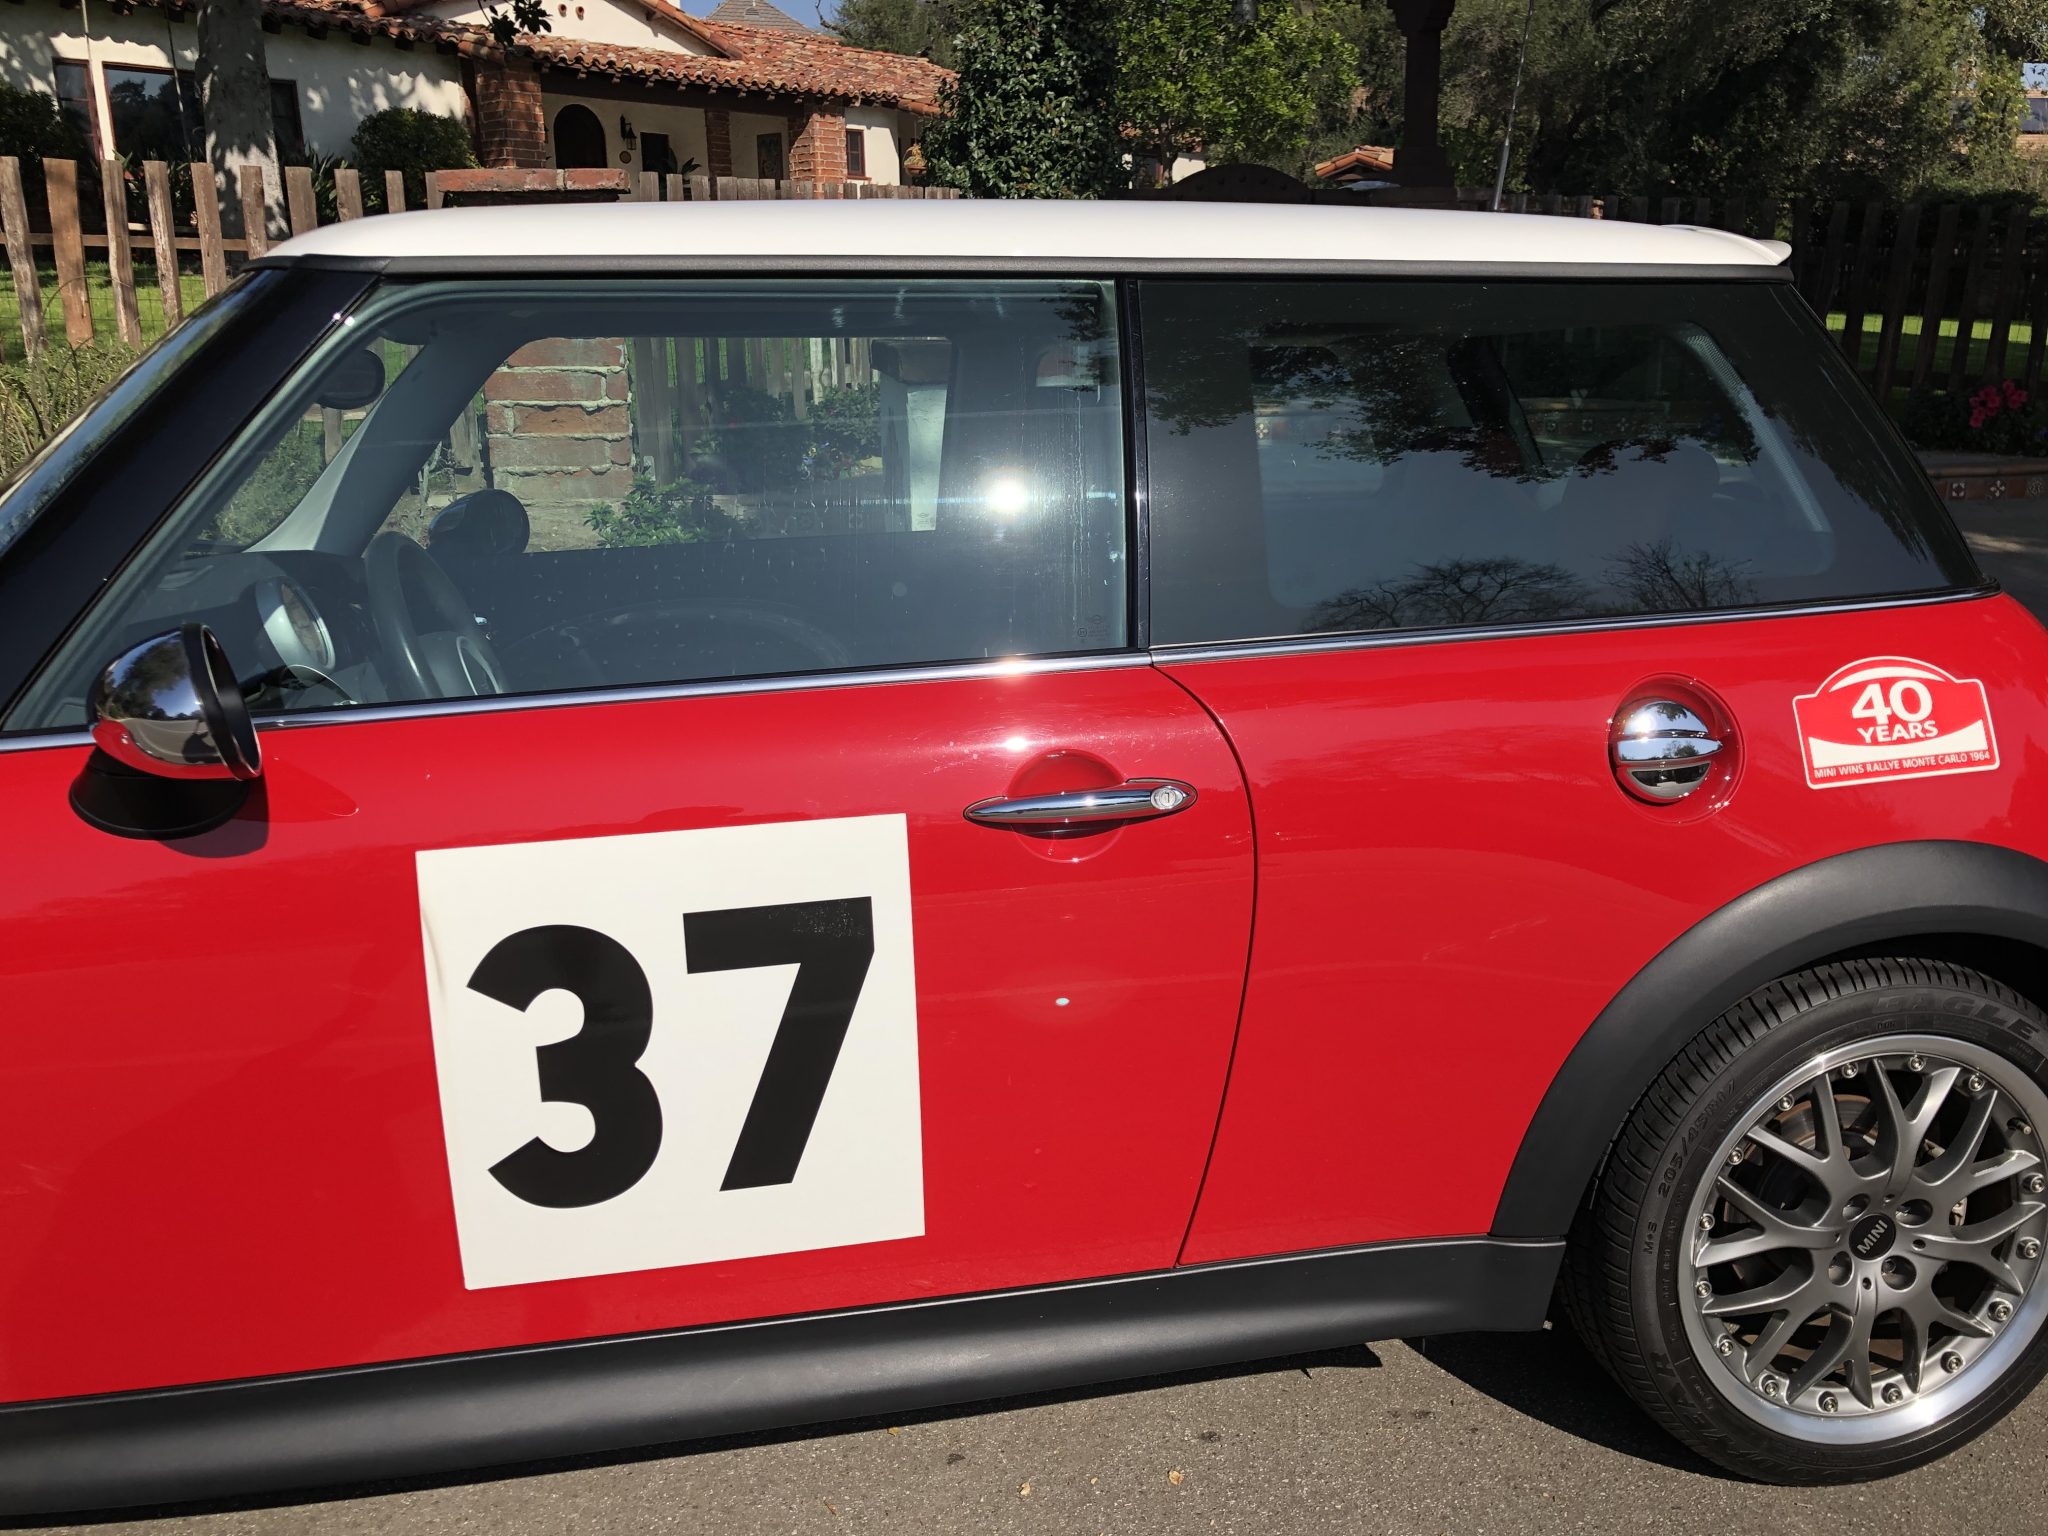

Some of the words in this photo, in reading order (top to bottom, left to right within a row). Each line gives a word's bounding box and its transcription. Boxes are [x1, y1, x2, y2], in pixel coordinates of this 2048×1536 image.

[1851, 679, 1933, 725] 40
[1856, 720, 1939, 743] YEARS
[1813, 766, 1837, 779] MINI
[1838, 764, 1865, 776] WINS
[1866, 760, 1901, 773] RALLYE
[1902, 756, 1937, 769] MONTE
[1938, 752, 1968, 766] CARLO
[1969, 750, 1991, 762] 1964
[466, 896, 875, 1209] 37
[1857, 1220, 1888, 1254] MINI
